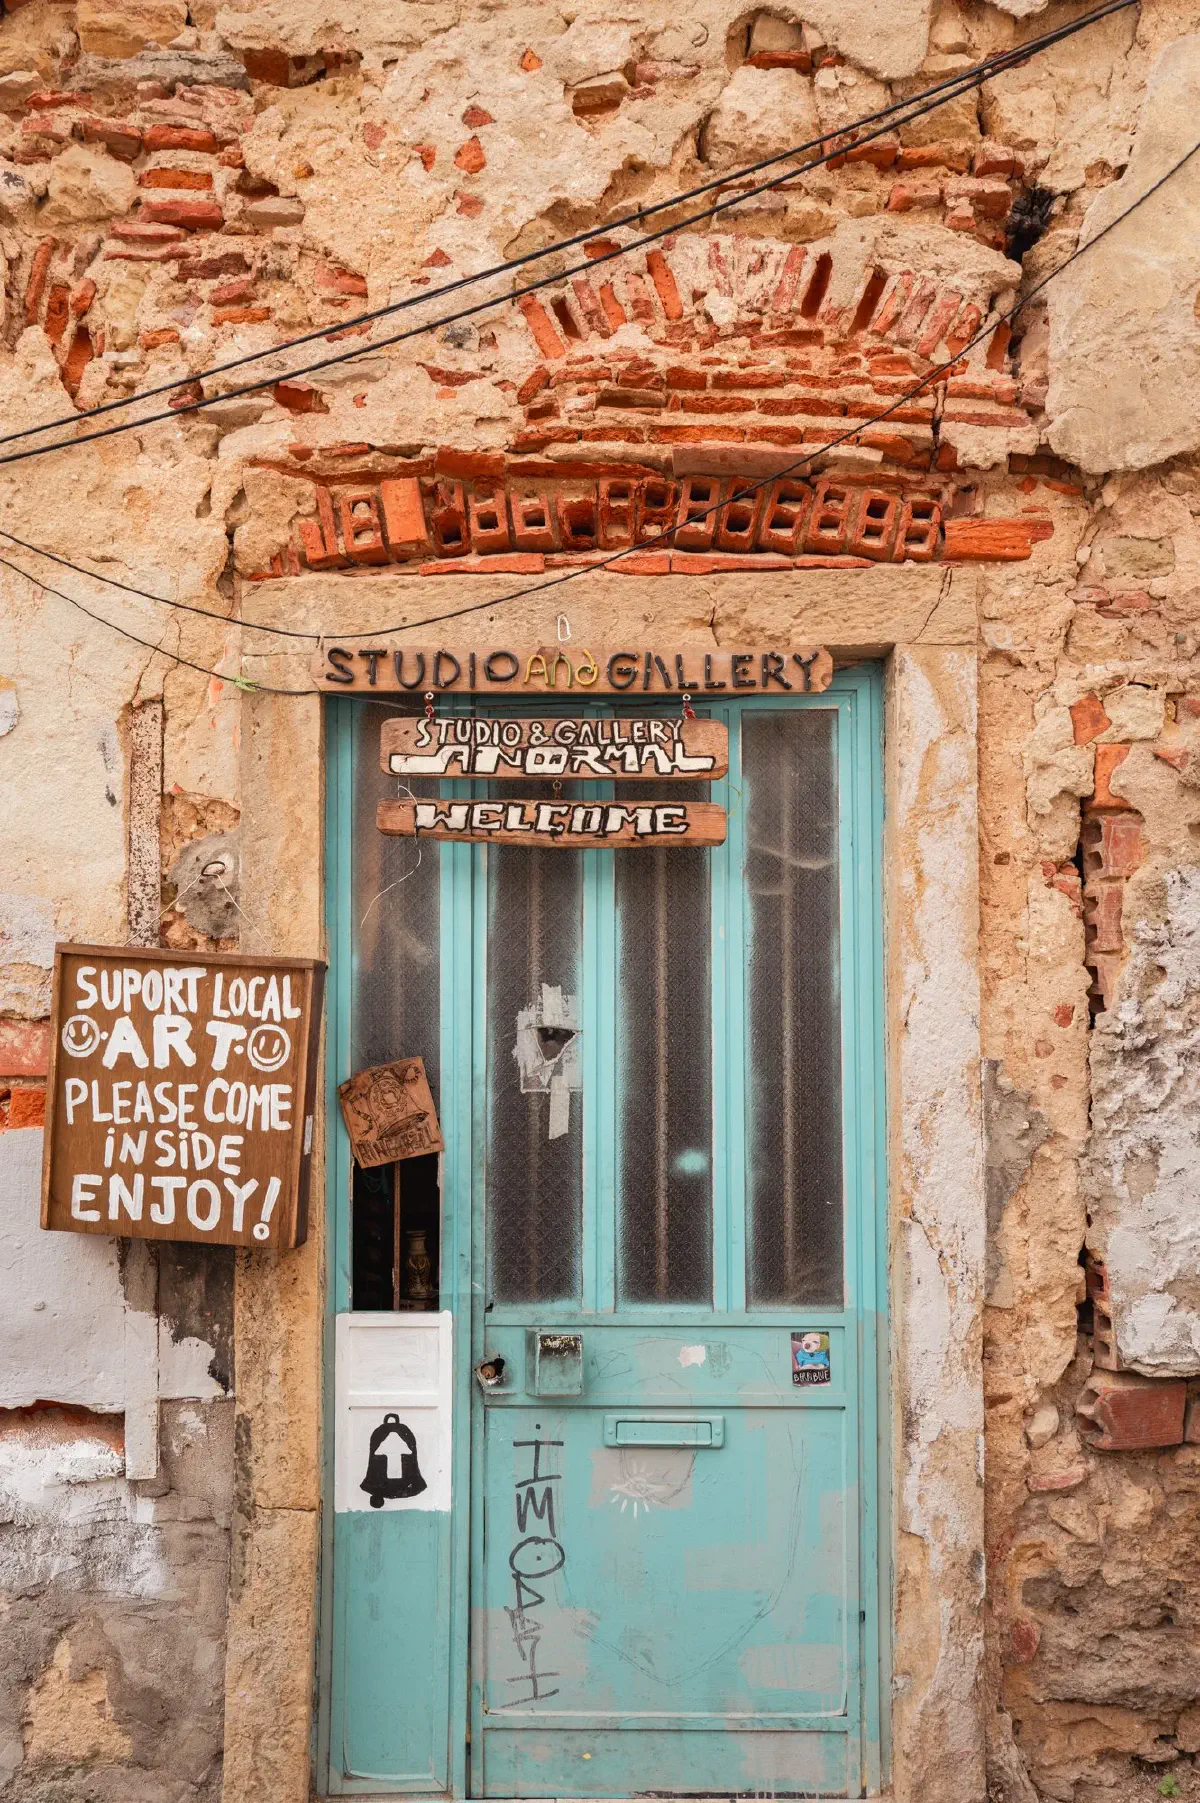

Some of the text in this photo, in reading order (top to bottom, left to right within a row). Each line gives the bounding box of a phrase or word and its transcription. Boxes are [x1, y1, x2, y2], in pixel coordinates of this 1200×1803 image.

[325, 646, 520, 690] STUDIO
[606, 649, 820, 692] GALLERY
[416, 718, 521, 748] STUDIO
[553, 718, 684, 745] GALLERY
[389, 743, 715, 775] ANORMAL
[414, 802, 691, 835] WELCOME
[76, 966, 302, 1023] SUPORT LOCAL
[65, 1077, 293, 1132] PLEASE COME
[71, 1173, 282, 1241] ENJOY!
